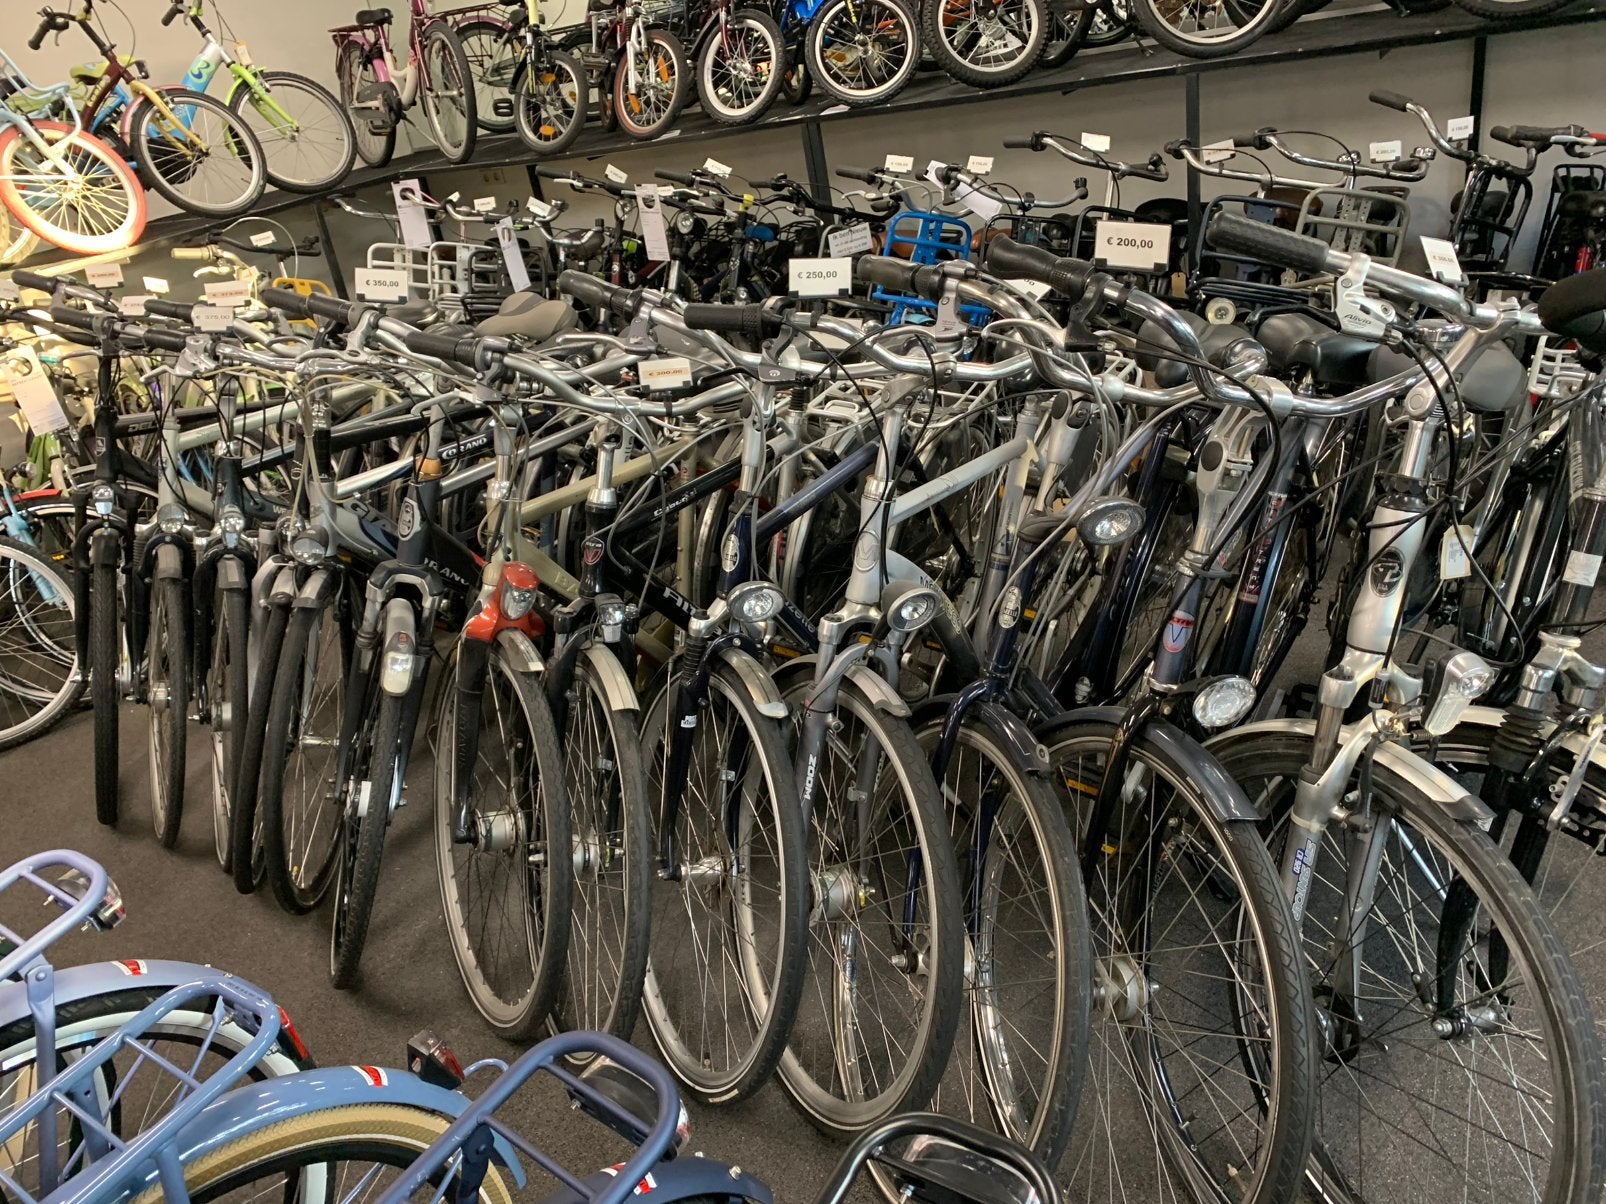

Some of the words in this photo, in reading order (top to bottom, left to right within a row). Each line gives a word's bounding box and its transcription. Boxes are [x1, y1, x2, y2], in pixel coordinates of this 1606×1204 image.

[1106, 237, 1113, 245] €
[1116, 237, 1154, 249] 200,00
[806, 271, 837, 280] 250,00
[803, 753, 817, 800] ZOOM
